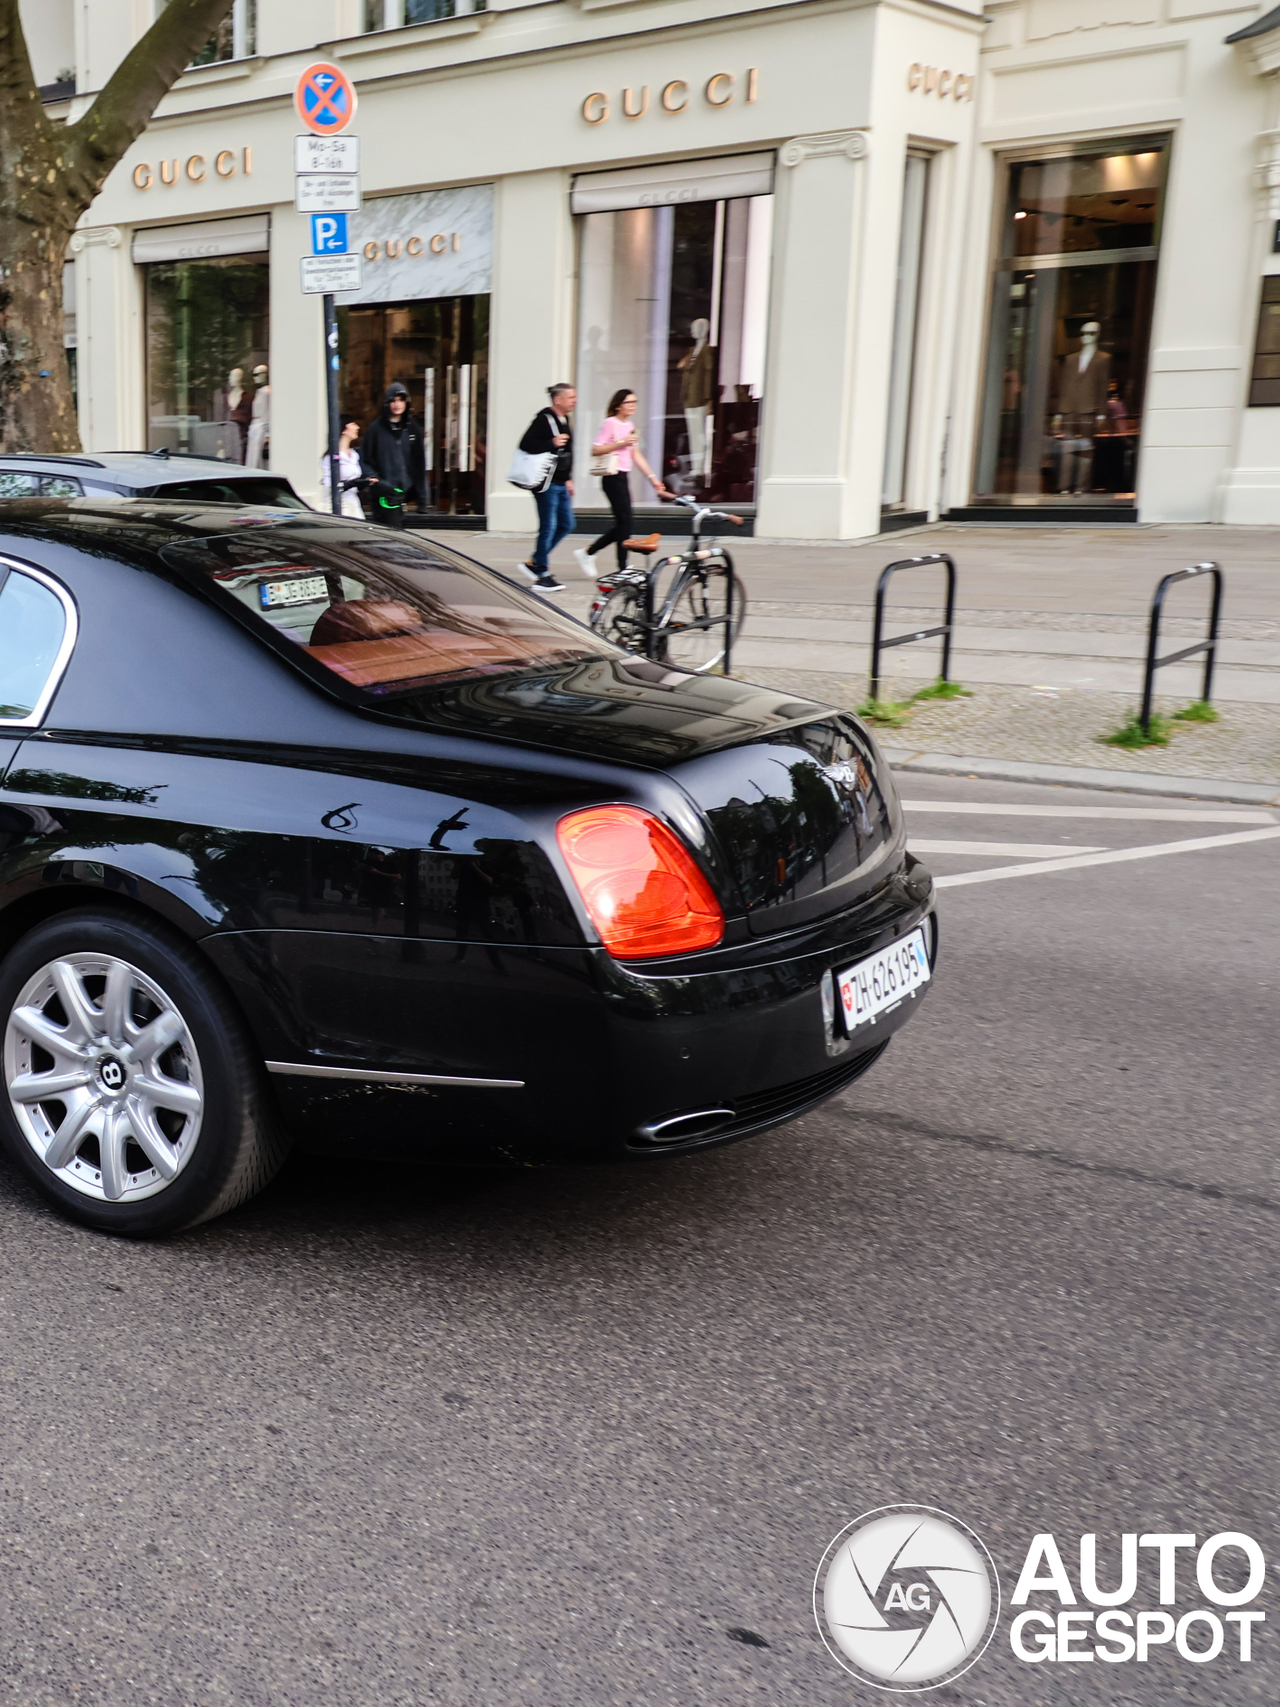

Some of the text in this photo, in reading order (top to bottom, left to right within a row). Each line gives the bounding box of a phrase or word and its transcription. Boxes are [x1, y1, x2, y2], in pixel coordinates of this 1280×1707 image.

[582, 68, 758, 125] GUCCI
[906, 62, 976, 103] GUCCI
[307, 140, 346, 152] Mo-Sa
[133, 146, 252, 190] GUCCI
[315, 217, 338, 250] P
[364, 232, 461, 261] GUCCI
